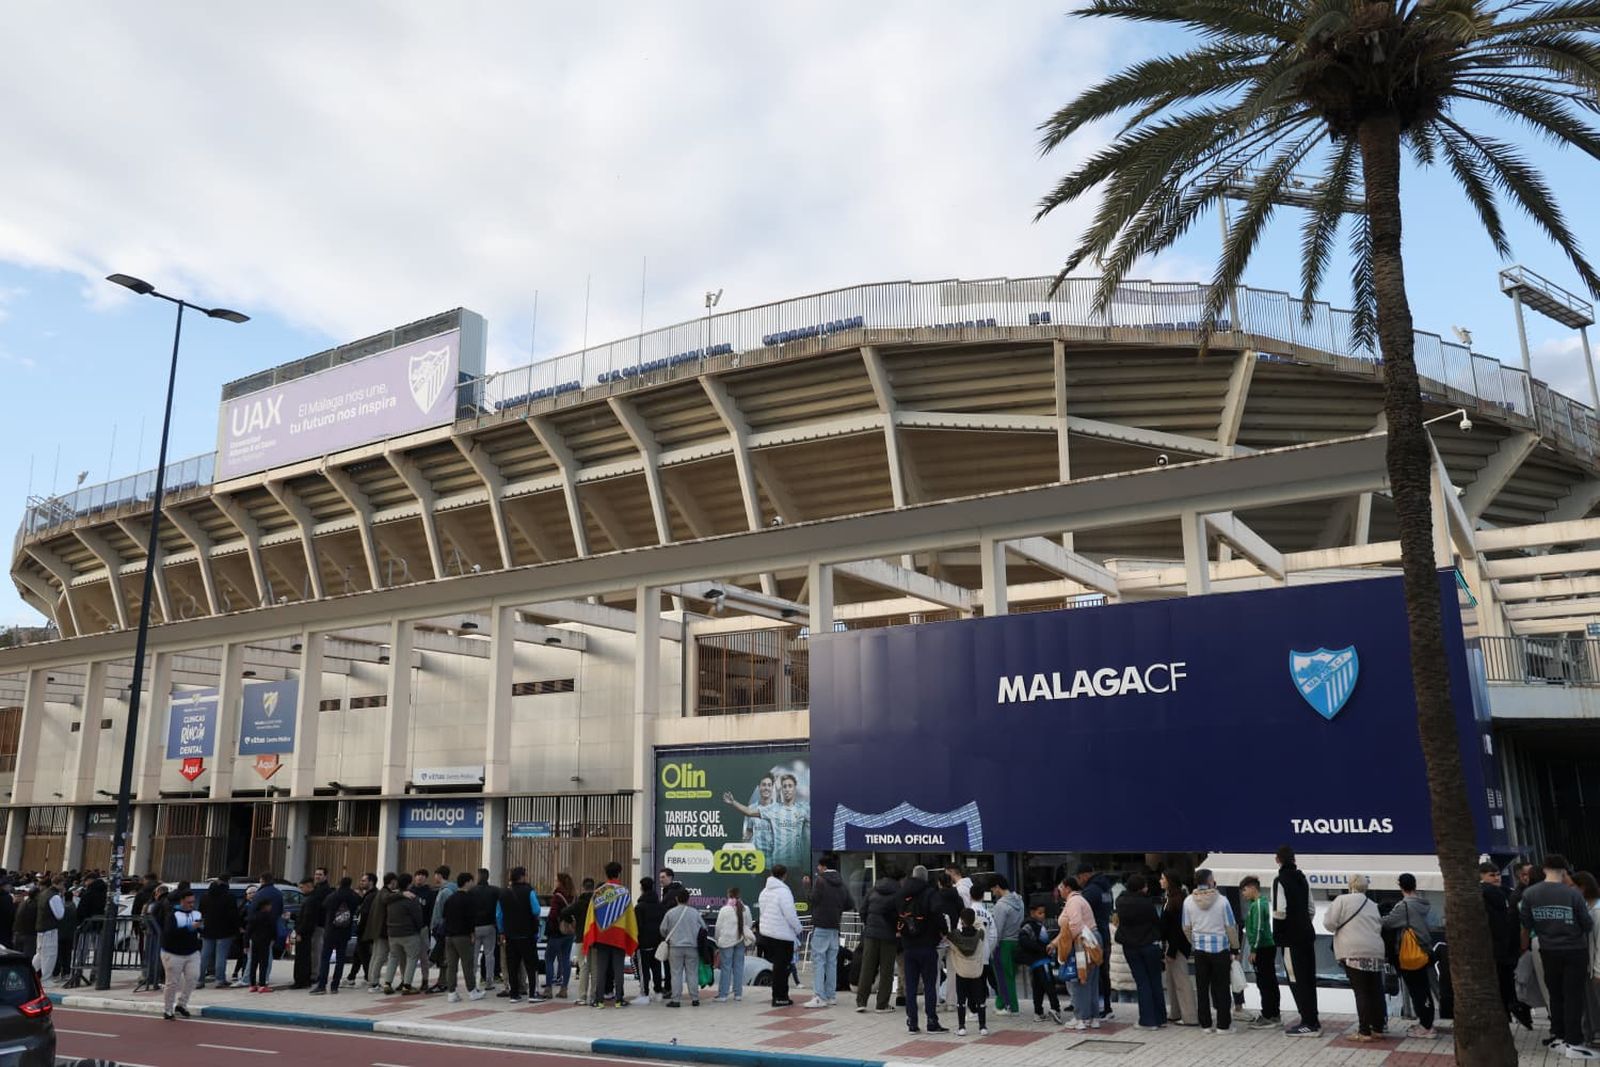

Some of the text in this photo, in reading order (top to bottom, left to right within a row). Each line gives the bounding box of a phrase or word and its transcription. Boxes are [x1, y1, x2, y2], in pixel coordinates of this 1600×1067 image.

[345, 389, 364, 404] nos
[232, 394, 284, 437] UAX
[290, 395, 397, 434] tu futuro nos inspira
[179, 745, 203, 755] DENTAL
[661, 763, 706, 789] Olin
[410, 801, 465, 826] málaga
[664, 810, 720, 825] TARIFAS QUE
[664, 824, 728, 838] VAN DE CARA.
[1291, 818, 1394, 834] TAQUILLAS
[864, 834, 945, 845] TIENDA OFICIAL
[720, 852, 757, 872] 20€
